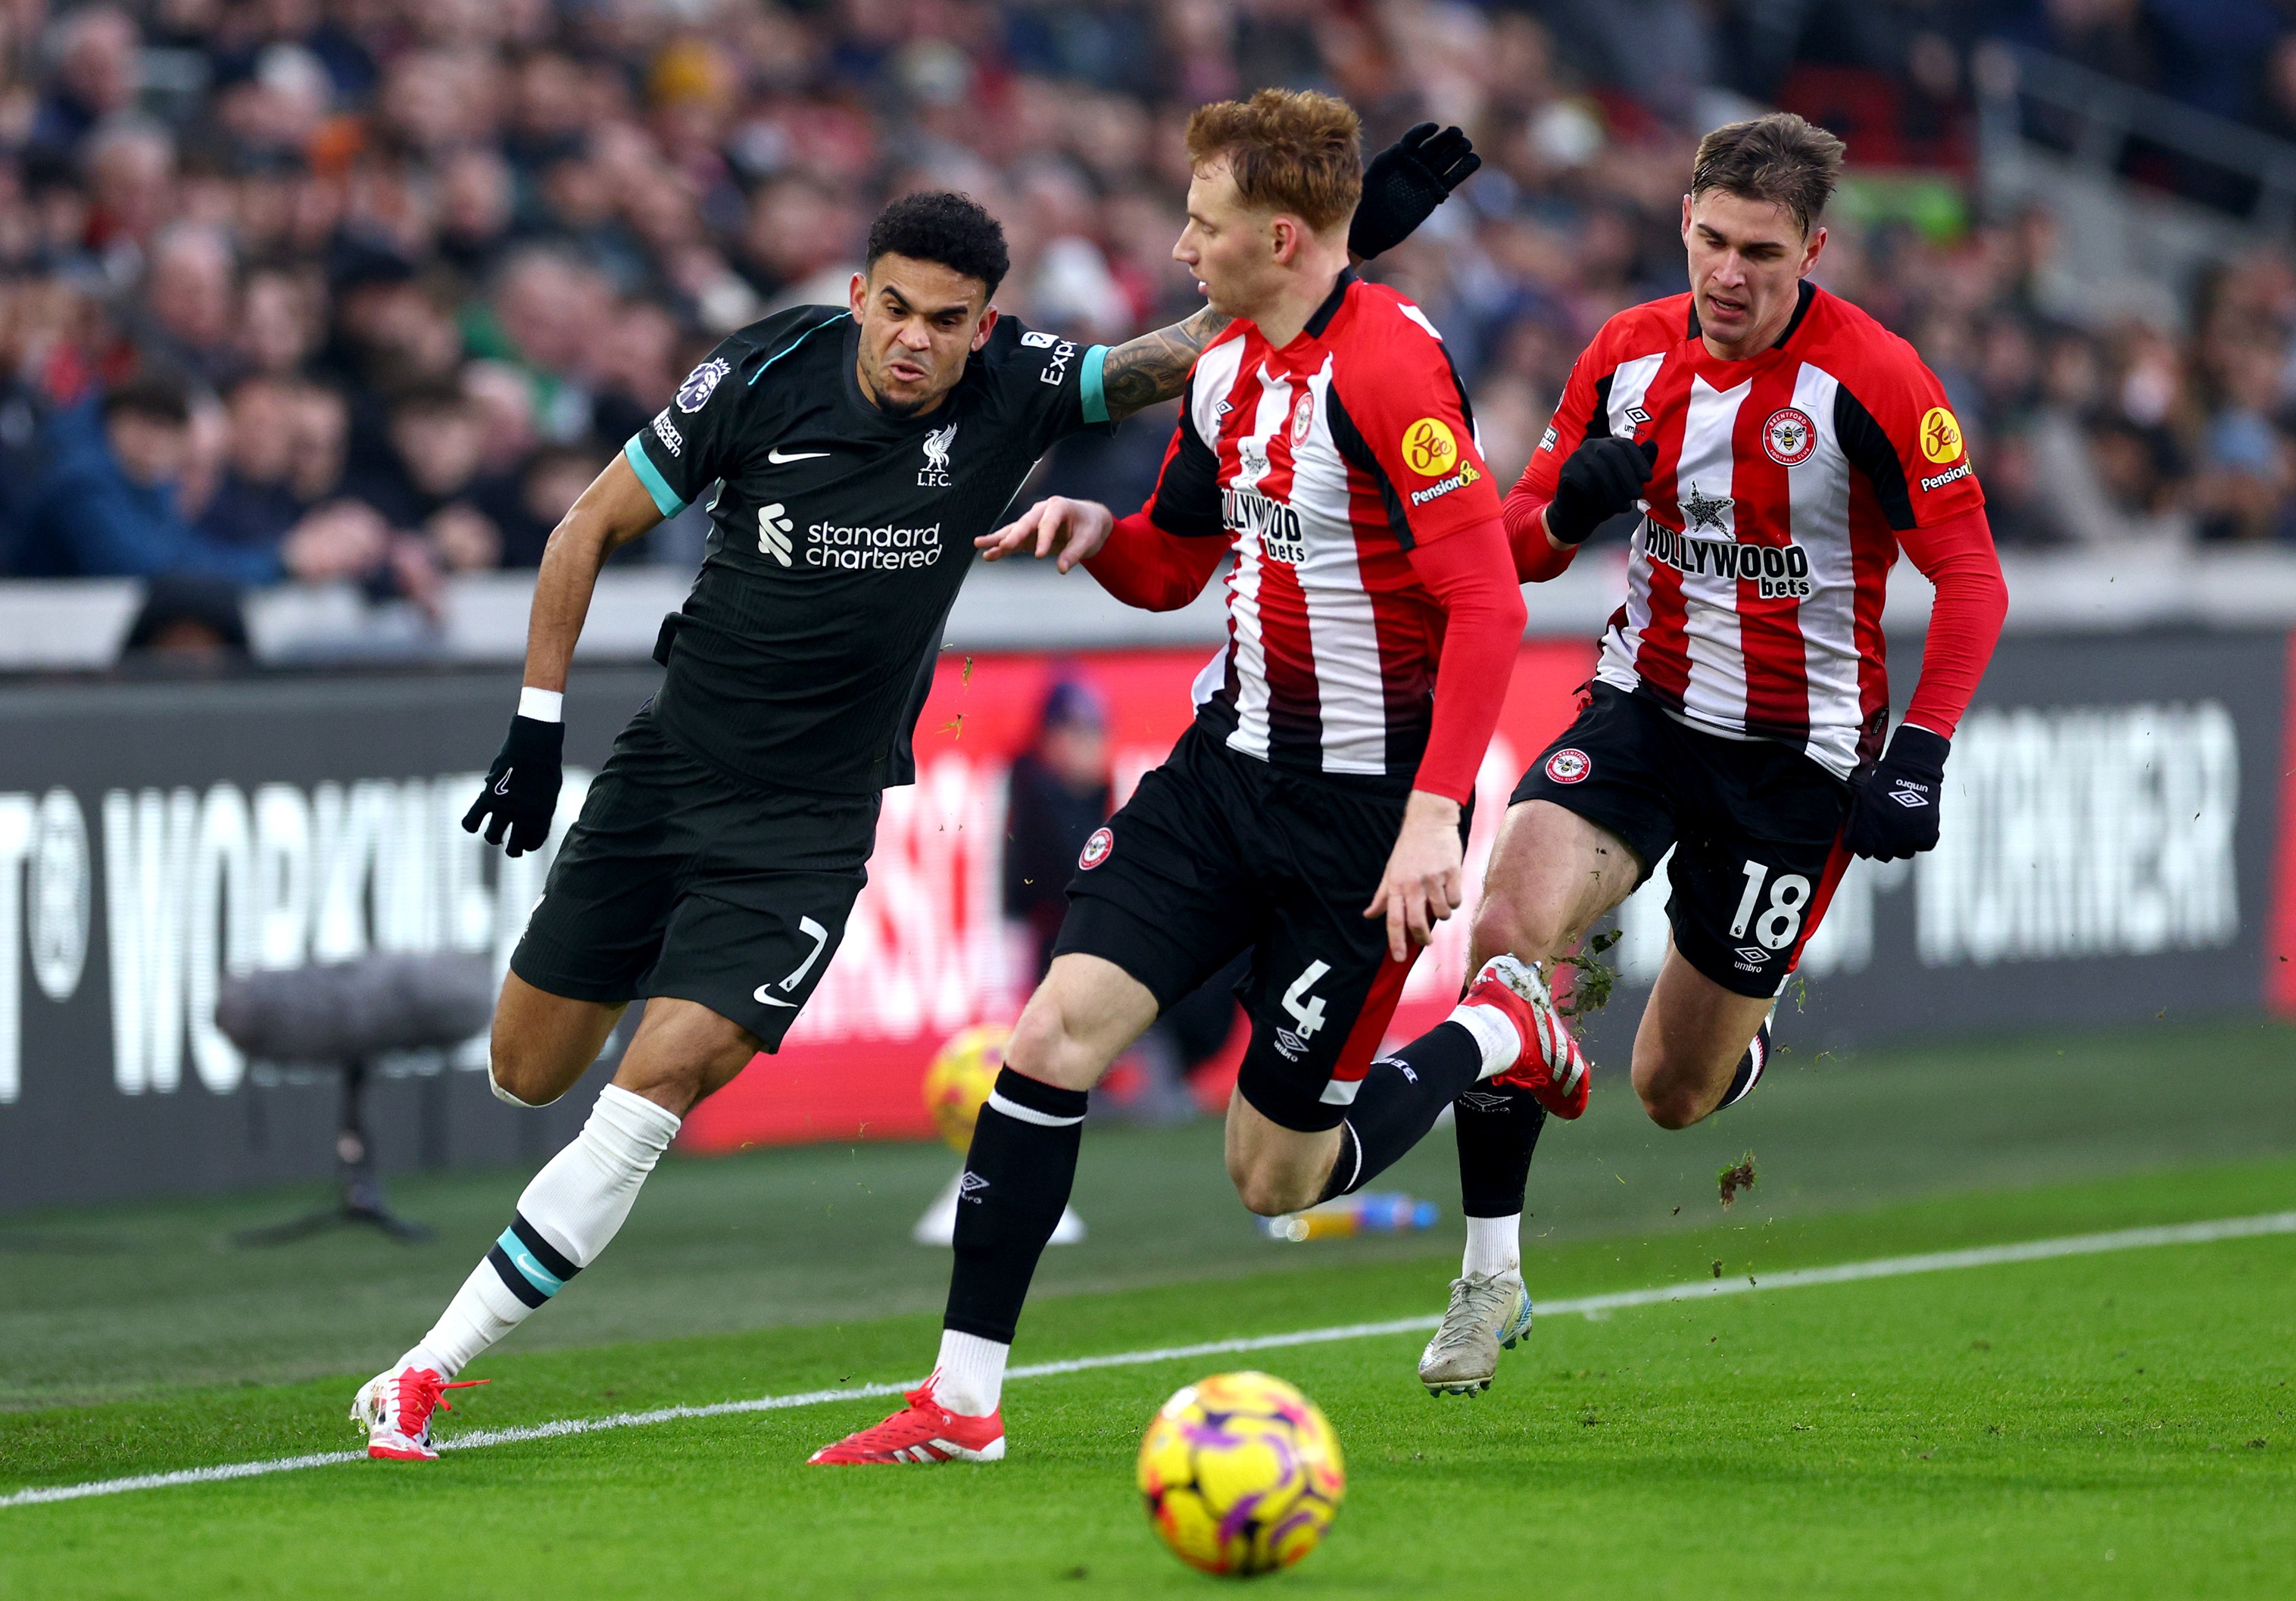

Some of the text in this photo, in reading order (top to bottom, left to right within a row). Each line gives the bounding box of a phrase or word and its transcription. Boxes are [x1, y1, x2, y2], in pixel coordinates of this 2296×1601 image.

[1624, 424, 1646, 436] umbro
[1769, 412, 1808, 427] BRENTFORD
[1412, 423, 1452, 469] Bee
[1926, 411, 1959, 457] Bee
[1770, 448, 1810, 462] FOOTBALL CLUB
[807, 520, 941, 548] standard
[805, 544, 943, 570] chartered
[1267, 537, 1305, 562] bets
[1645, 518, 1809, 579] HOLLYWOOD
[1761, 576, 1811, 596] bets
[1895, 779, 1929, 793] umbro
[1729, 860, 1811, 950] 18
[778, 915, 828, 993] 7
[1734, 961, 1762, 973] umbro
[1281, 959, 1331, 1041] 4
[1274, 1040, 1299, 1063] umbro
